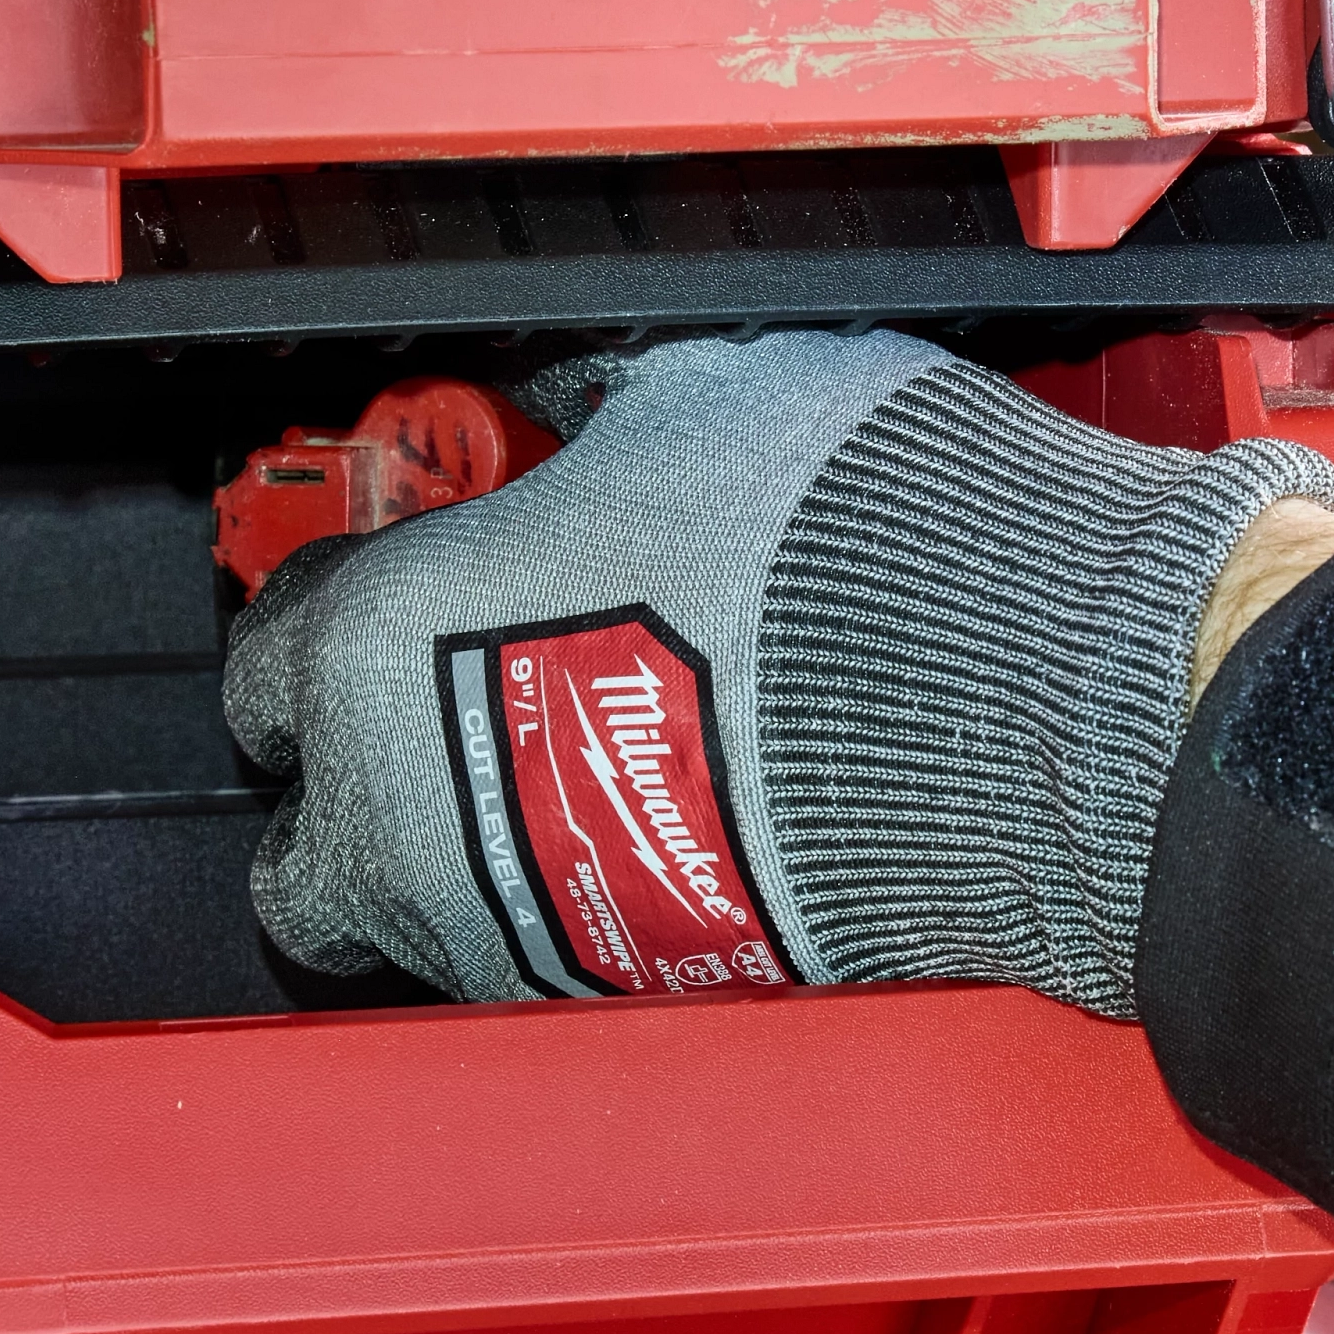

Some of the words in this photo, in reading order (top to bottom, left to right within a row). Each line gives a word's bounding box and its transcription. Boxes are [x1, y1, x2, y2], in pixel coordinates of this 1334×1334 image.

[465, 708, 495, 780] CUT
[479, 791, 521, 898] LEVEL
[515, 906, 537, 928] 4
[566, 878, 611, 965] 48-73-8742
[706, 953, 732, 980] EN388
[737, 952, 763, 977] A4
